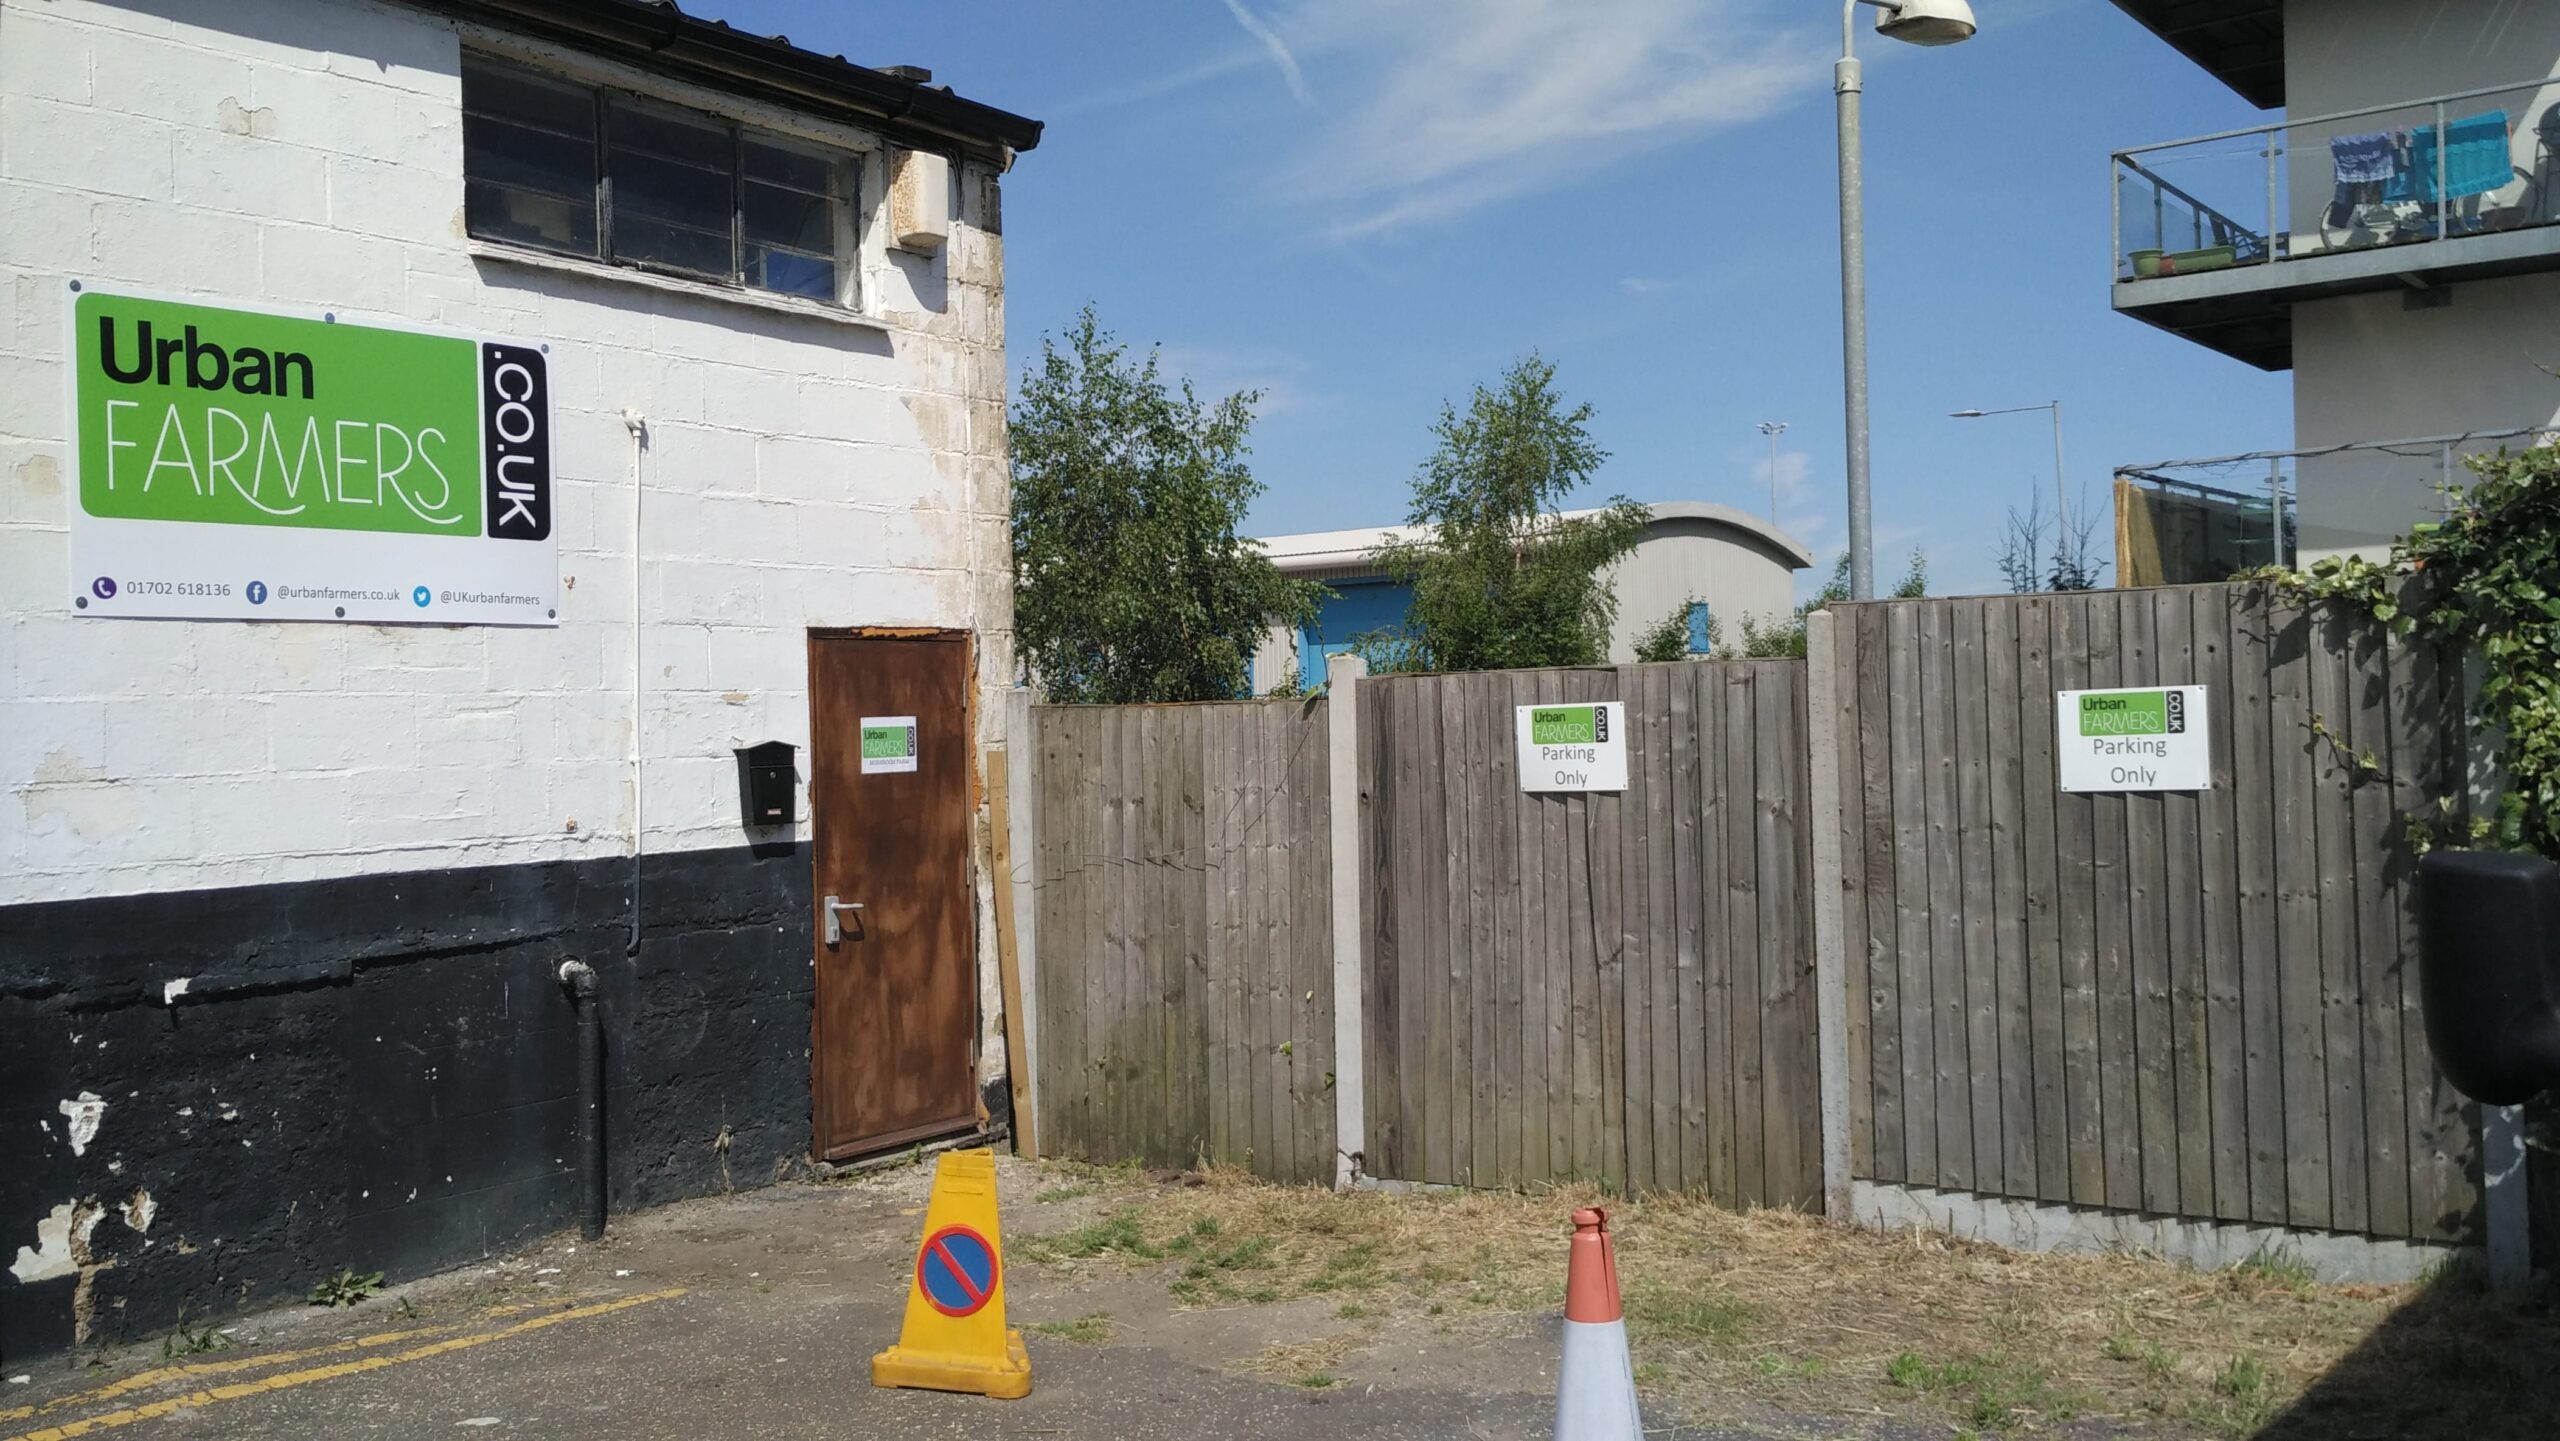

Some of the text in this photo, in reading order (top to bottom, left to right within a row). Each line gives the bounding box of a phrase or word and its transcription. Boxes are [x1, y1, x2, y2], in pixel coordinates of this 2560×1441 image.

[99, 315, 314, 399] Urban
[106, 399, 464, 524] FARMERS
[126, 581, 231, 597] 01702 618136
[277, 585, 400, 603] @urbanfarmers.co.uk
[440, 589, 541, 606] @UKurbanfarmers
[2082, 697, 2127, 711] Urban
[1534, 711, 1566, 723] Urban
[2083, 711, 2162, 734] FARMERS
[864, 729, 888, 740] Urban
[1535, 723, 1592, 743] FARMERS
[1542, 745, 1595, 763] Parking
[2094, 737, 2167, 758] Parking
[1554, 769, 1588, 788] Only
[2110, 765, 2157, 787] Only
